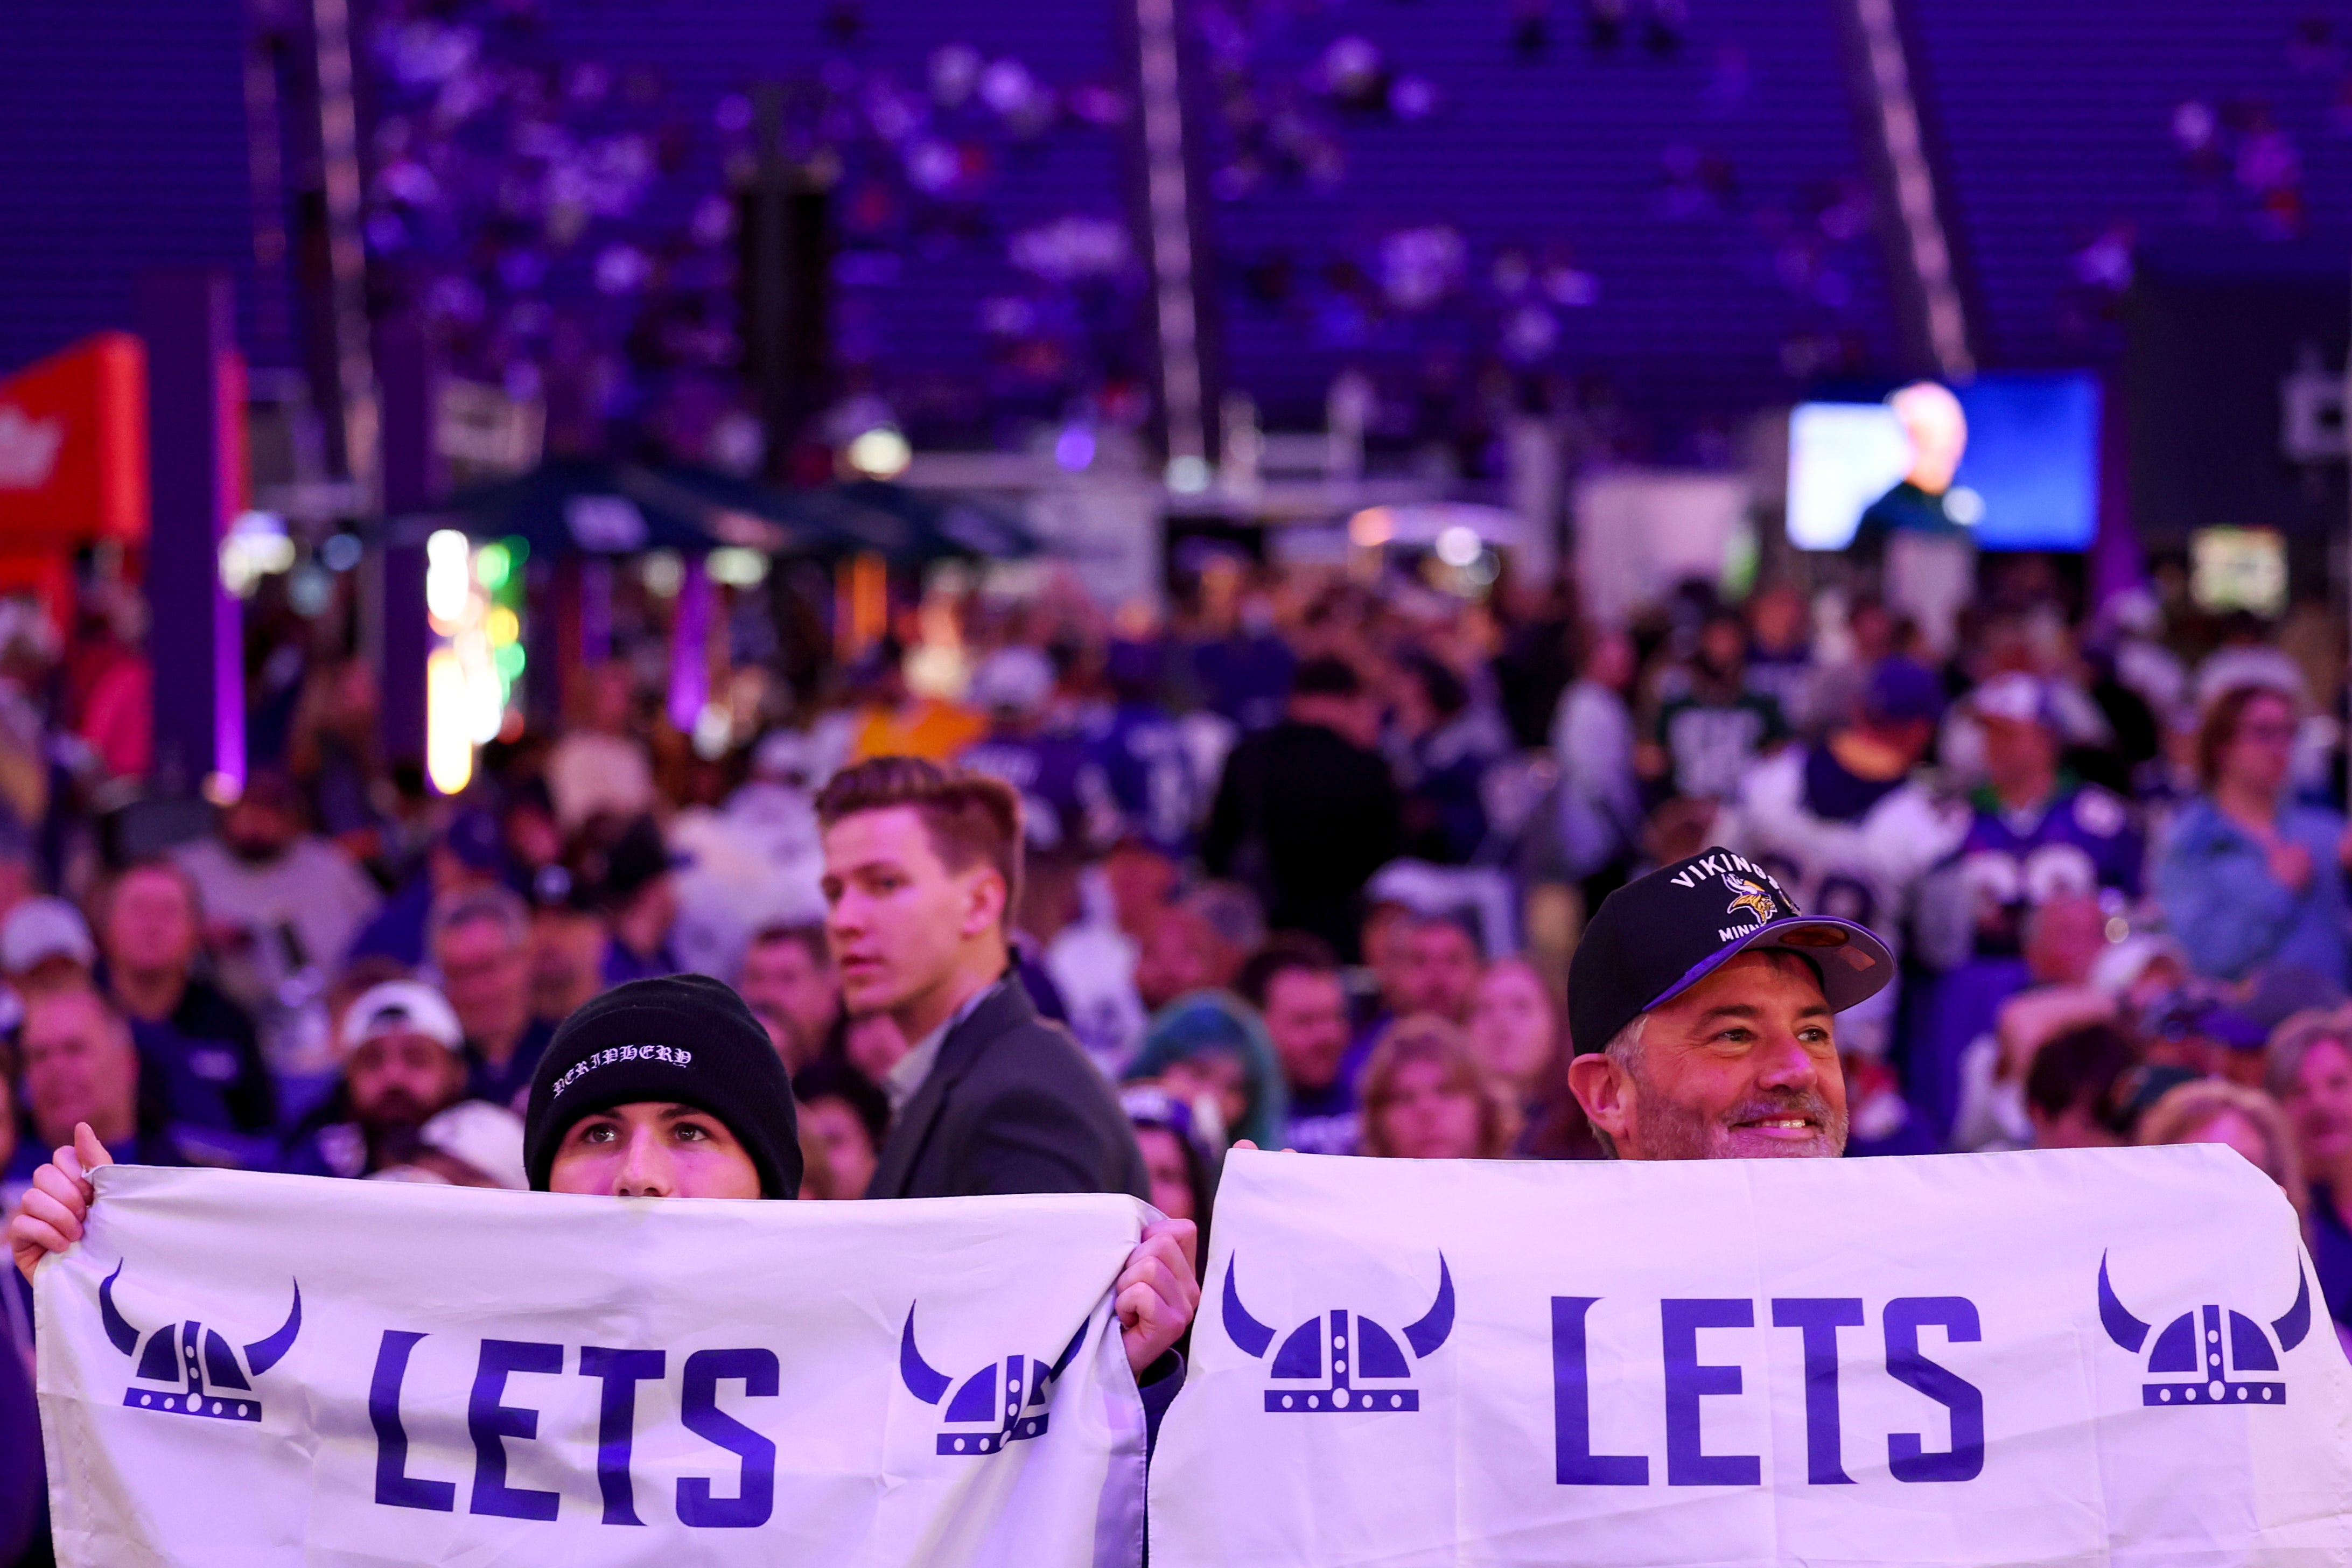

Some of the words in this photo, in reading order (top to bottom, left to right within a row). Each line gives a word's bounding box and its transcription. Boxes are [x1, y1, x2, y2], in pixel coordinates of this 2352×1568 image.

[1718, 923, 1765, 942] MINN
[552, 1045, 691, 1100] PERIPHERY
[369, 1329, 779, 1528] LETS
[1551, 1296, 1985, 1486] LETS
